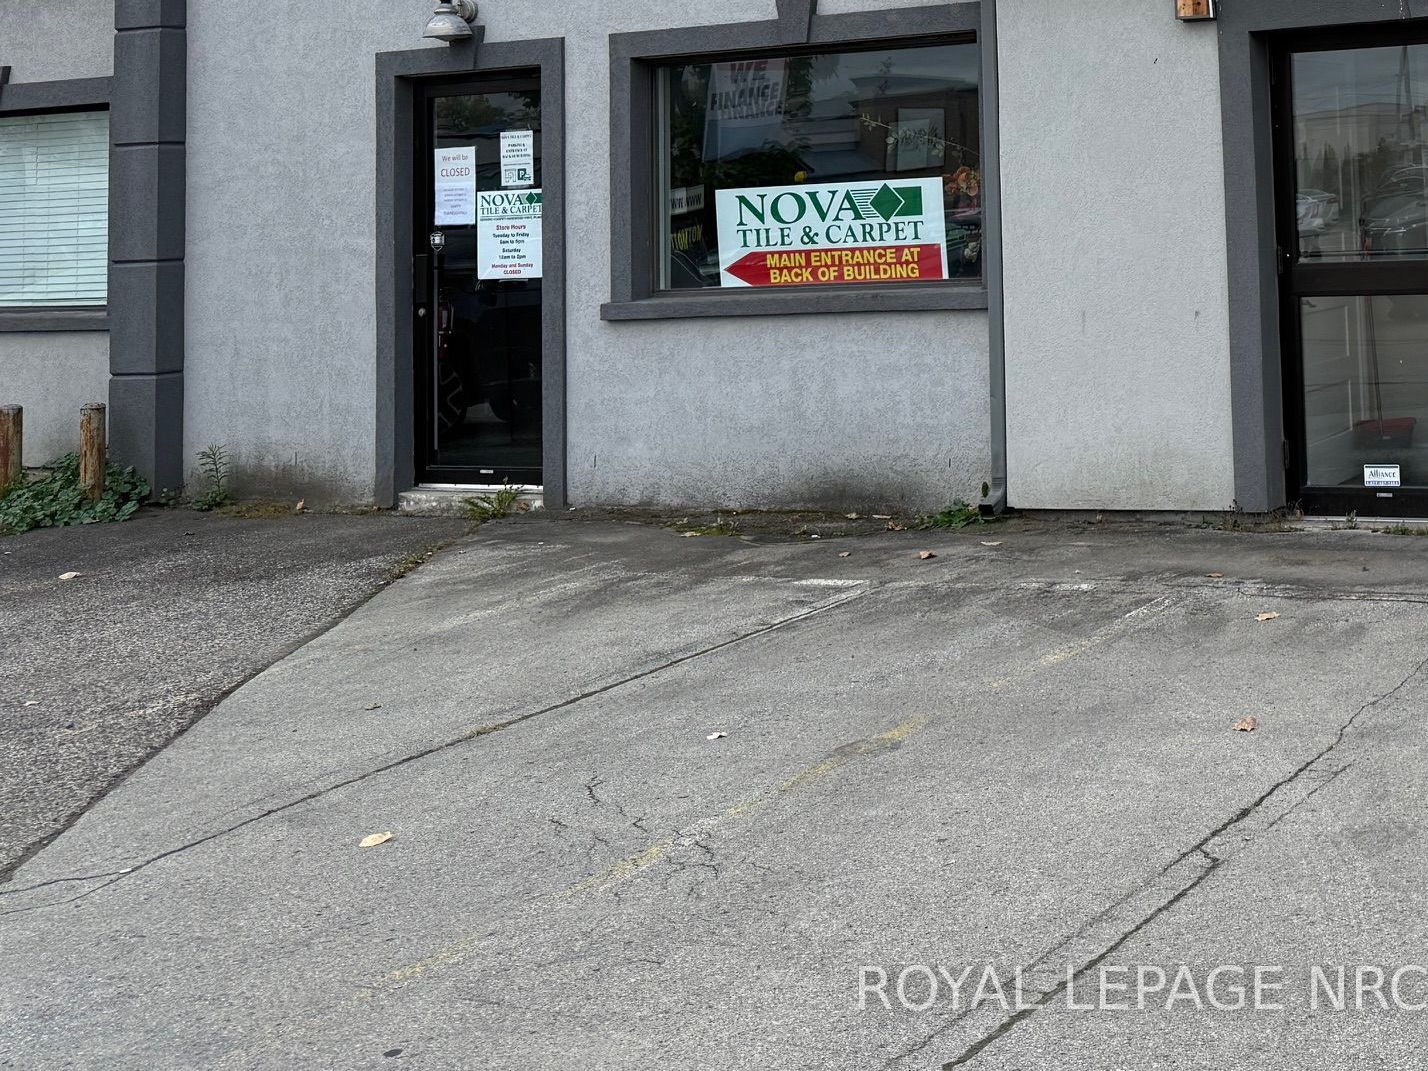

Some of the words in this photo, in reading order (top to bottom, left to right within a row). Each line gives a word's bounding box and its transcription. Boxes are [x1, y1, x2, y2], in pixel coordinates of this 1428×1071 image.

[730, 60, 769, 83] WE
[711, 82, 780, 111] FINANCE
[440, 167, 471, 177] CLOSED
[480, 193, 523, 207] NOVA
[480, 207, 500, 215] TILE
[501, 206, 509, 214] &
[736, 188, 867, 227] NOVA
[736, 227, 793, 248] TILE
[800, 225, 819, 245] &
[825, 220, 924, 244] CARPET
[766, 251, 807, 268] MAIN
[810, 249, 897, 267] ENTRANCE
[901, 247, 921, 262] AT
[769, 267, 812, 283] BACK
[817, 266, 839, 281] OF
[843, 263, 920, 280] BUILDING
